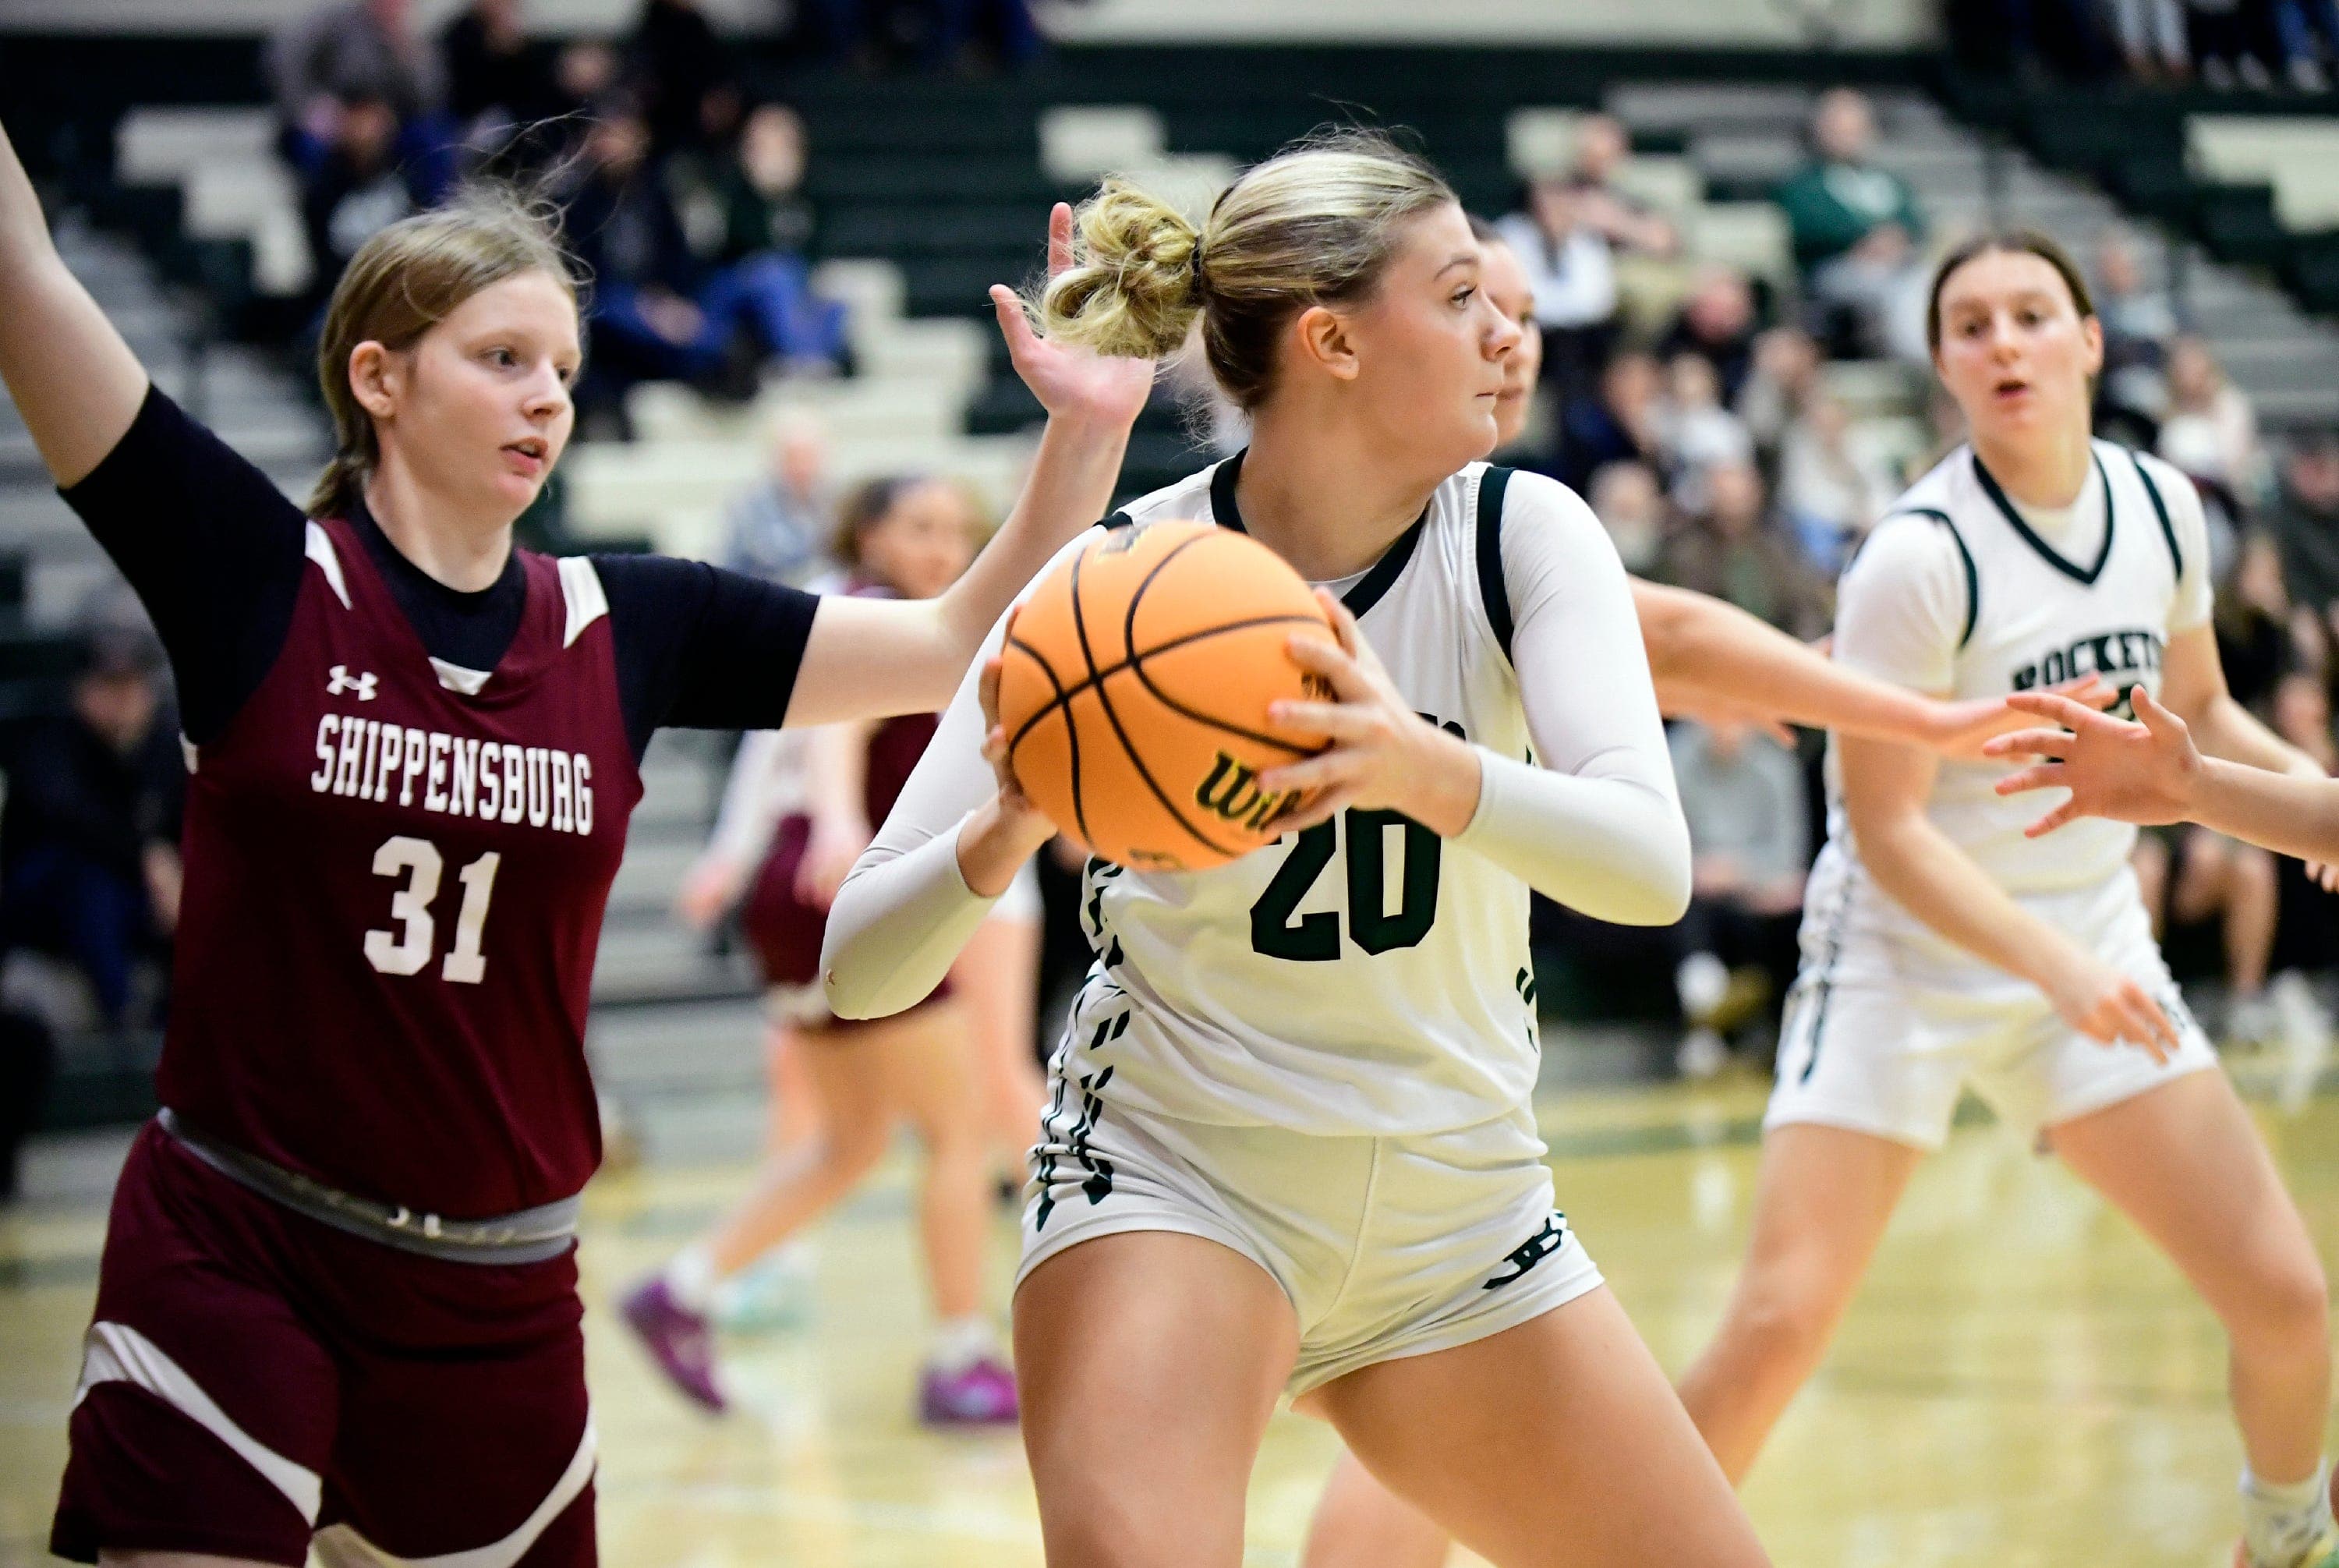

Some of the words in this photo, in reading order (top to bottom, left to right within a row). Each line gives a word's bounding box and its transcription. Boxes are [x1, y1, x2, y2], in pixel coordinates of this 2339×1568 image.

[2012, 631, 2161, 692] ROCKET
[312, 713, 594, 835] SHIPPENSBURG
[1194, 749, 1302, 833] Wil
[364, 836, 501, 984] 31
[1249, 806, 1442, 961] 20
